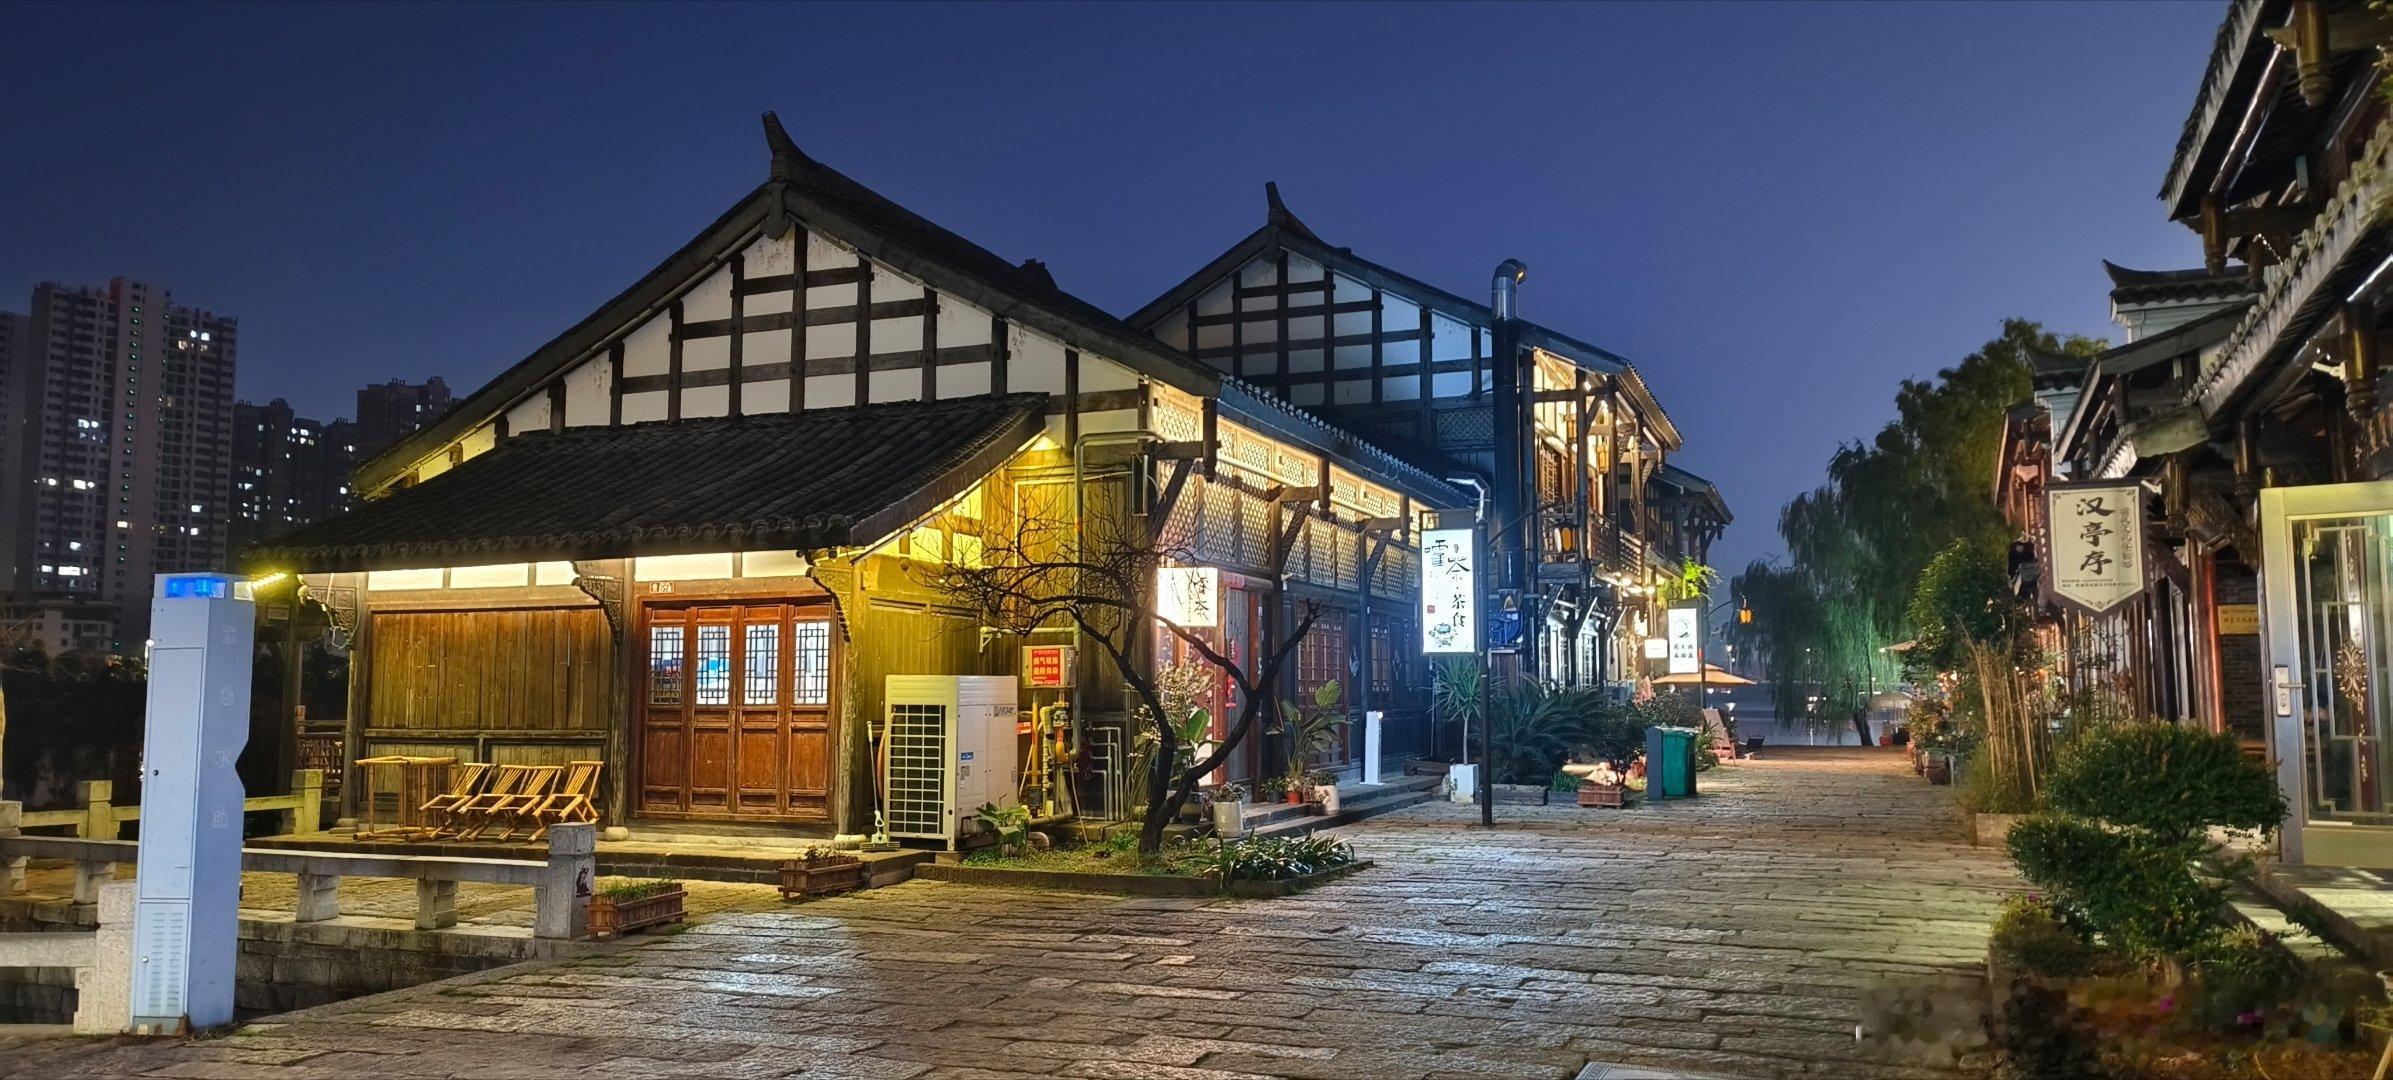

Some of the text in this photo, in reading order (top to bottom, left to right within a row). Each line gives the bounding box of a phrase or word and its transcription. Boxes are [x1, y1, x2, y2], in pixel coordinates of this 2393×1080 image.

[2076, 496, 2117, 575] 汉亭序
[212, 624, 238, 829] 紧急求助
